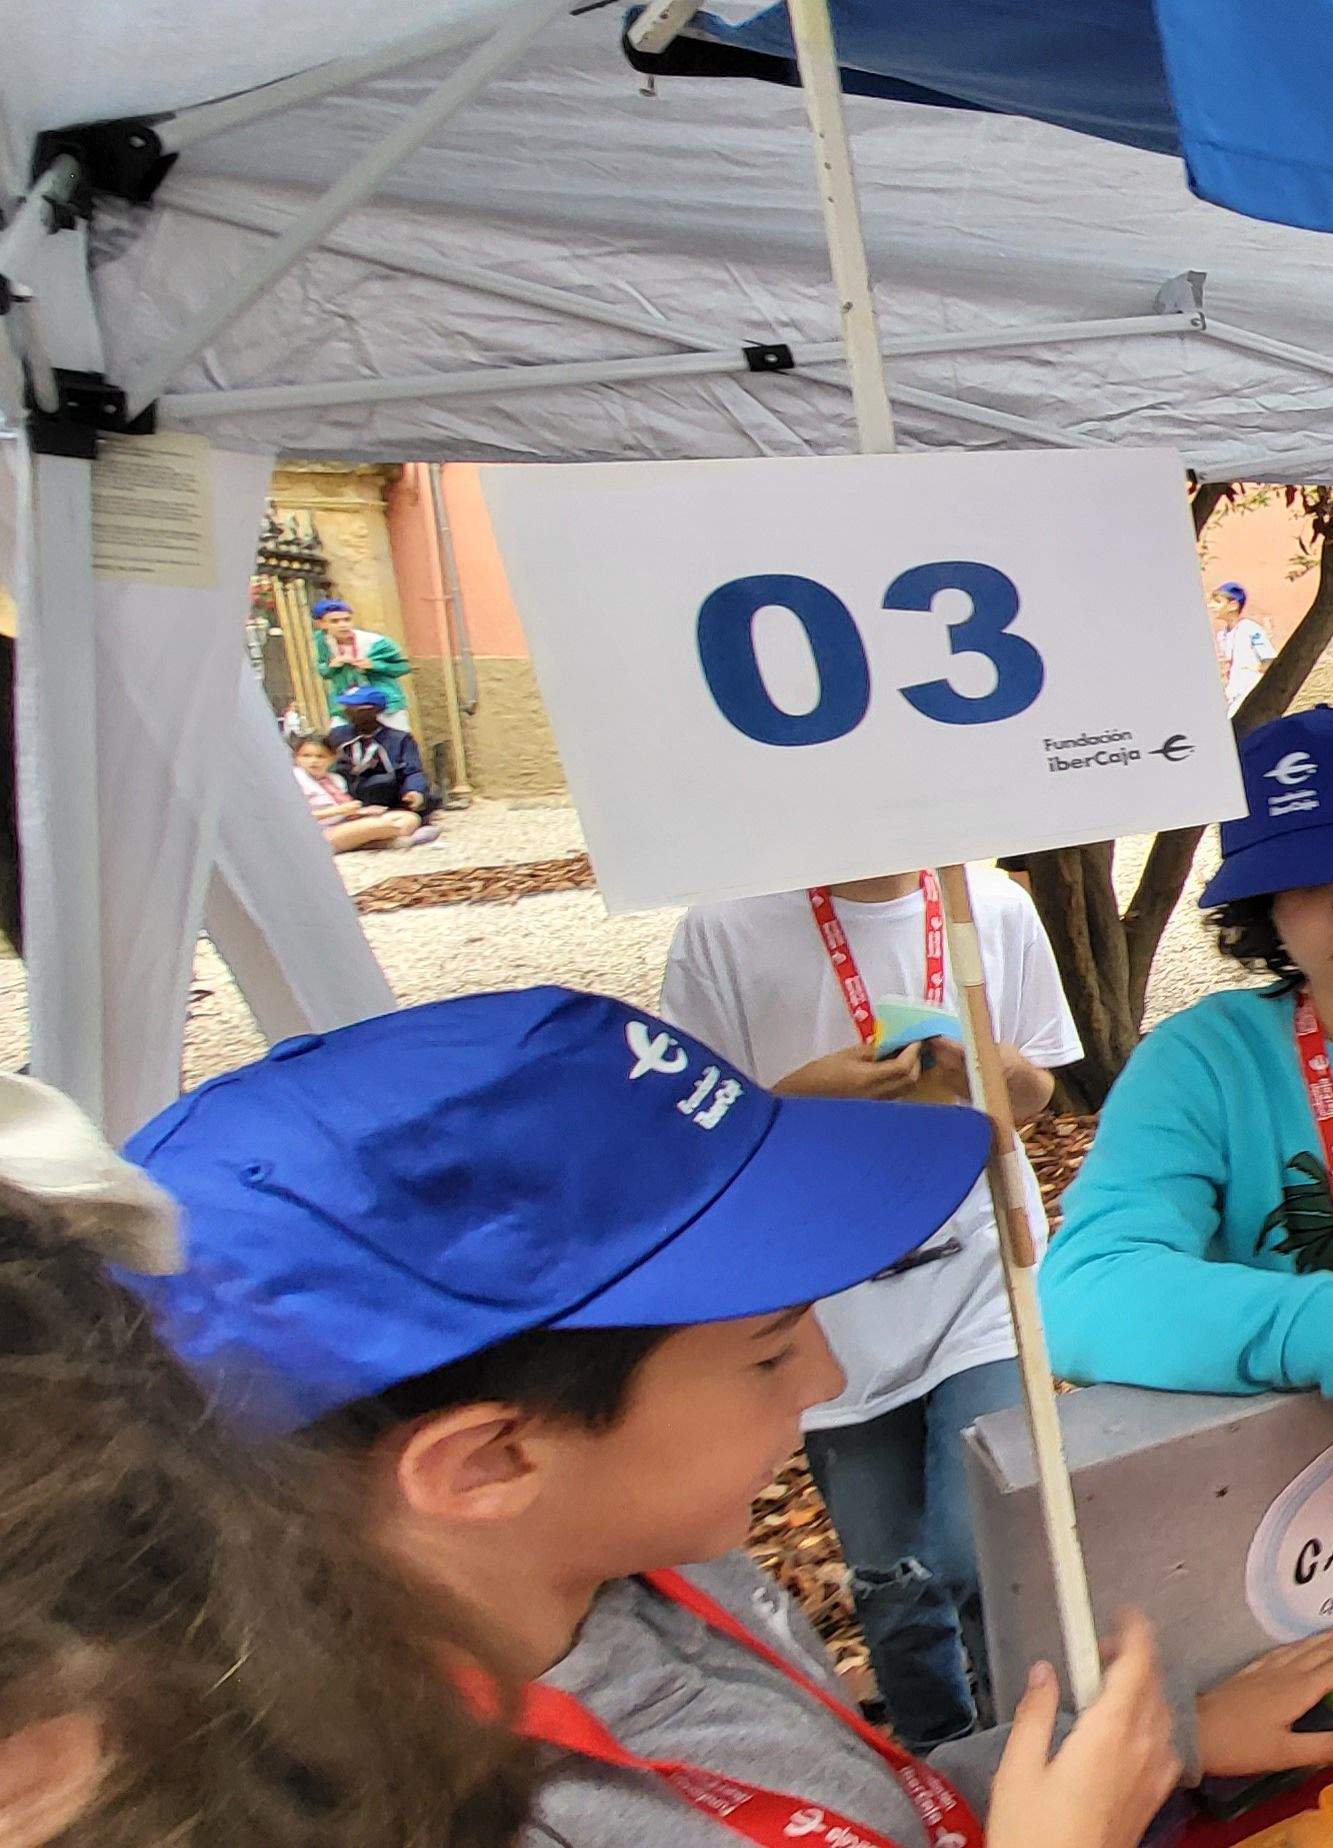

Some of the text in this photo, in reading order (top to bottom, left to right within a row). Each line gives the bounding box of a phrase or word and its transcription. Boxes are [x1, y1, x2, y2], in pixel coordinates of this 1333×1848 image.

[696, 560, 1046, 748] 03
[1043, 728, 1134, 752] Fundación
[1046, 747, 1142, 773] iberCaja
